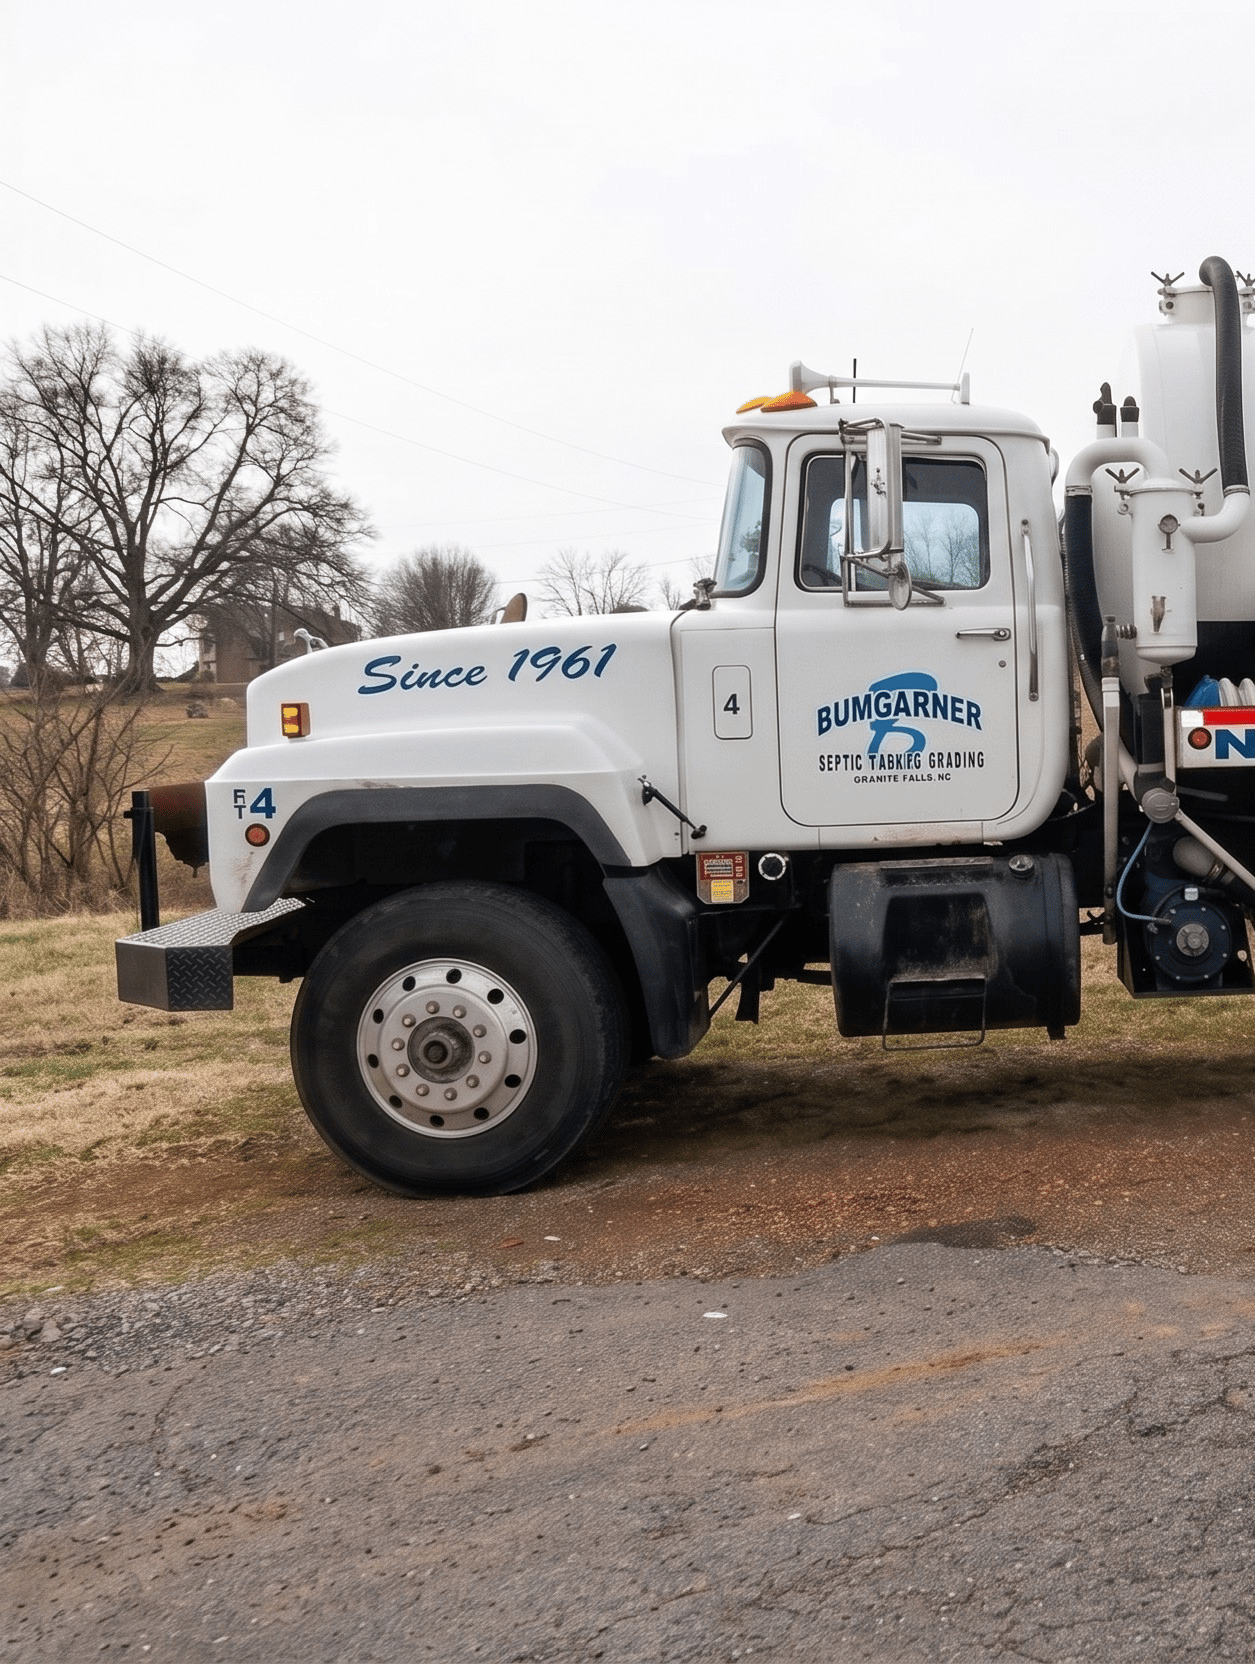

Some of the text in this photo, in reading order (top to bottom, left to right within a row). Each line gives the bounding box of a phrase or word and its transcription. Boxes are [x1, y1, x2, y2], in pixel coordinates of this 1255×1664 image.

[357, 643, 618, 695] Since 1961
[723, 693, 740, 715] 4
[817, 690, 983, 737] BUMGARNER
[819, 754, 863, 771] SEPTIC
[929, 751, 985, 769] GRADING
[853, 774, 899, 784] GRANITE
[938, 772, 951, 781] NC
[249, 787, 277, 819] 4
